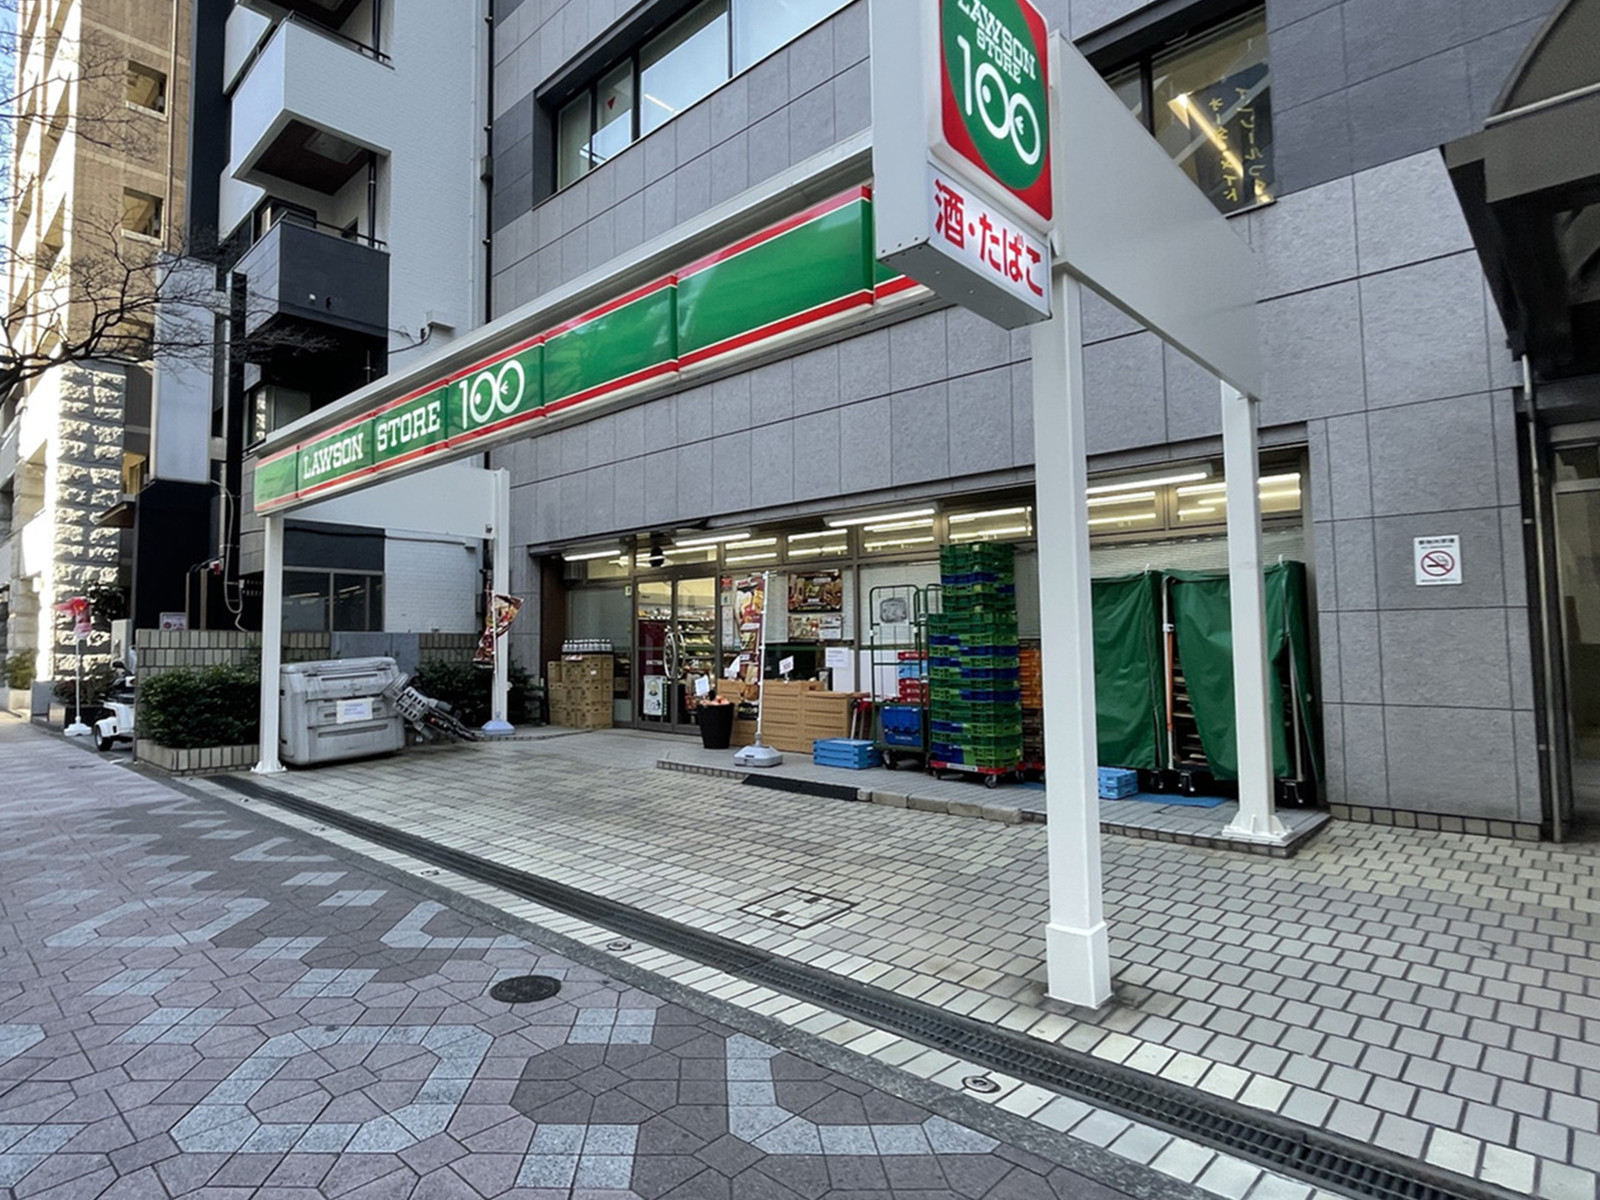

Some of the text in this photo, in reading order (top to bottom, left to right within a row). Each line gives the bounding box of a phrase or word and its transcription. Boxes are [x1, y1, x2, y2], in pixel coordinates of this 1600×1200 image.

[957, 35, 1042, 166] 100
[976, 27, 1021, 85] STORE
[934, 178, 1044, 297] 酒・たばこ
[303, 359, 525, 479] LAWSON STORE 100
